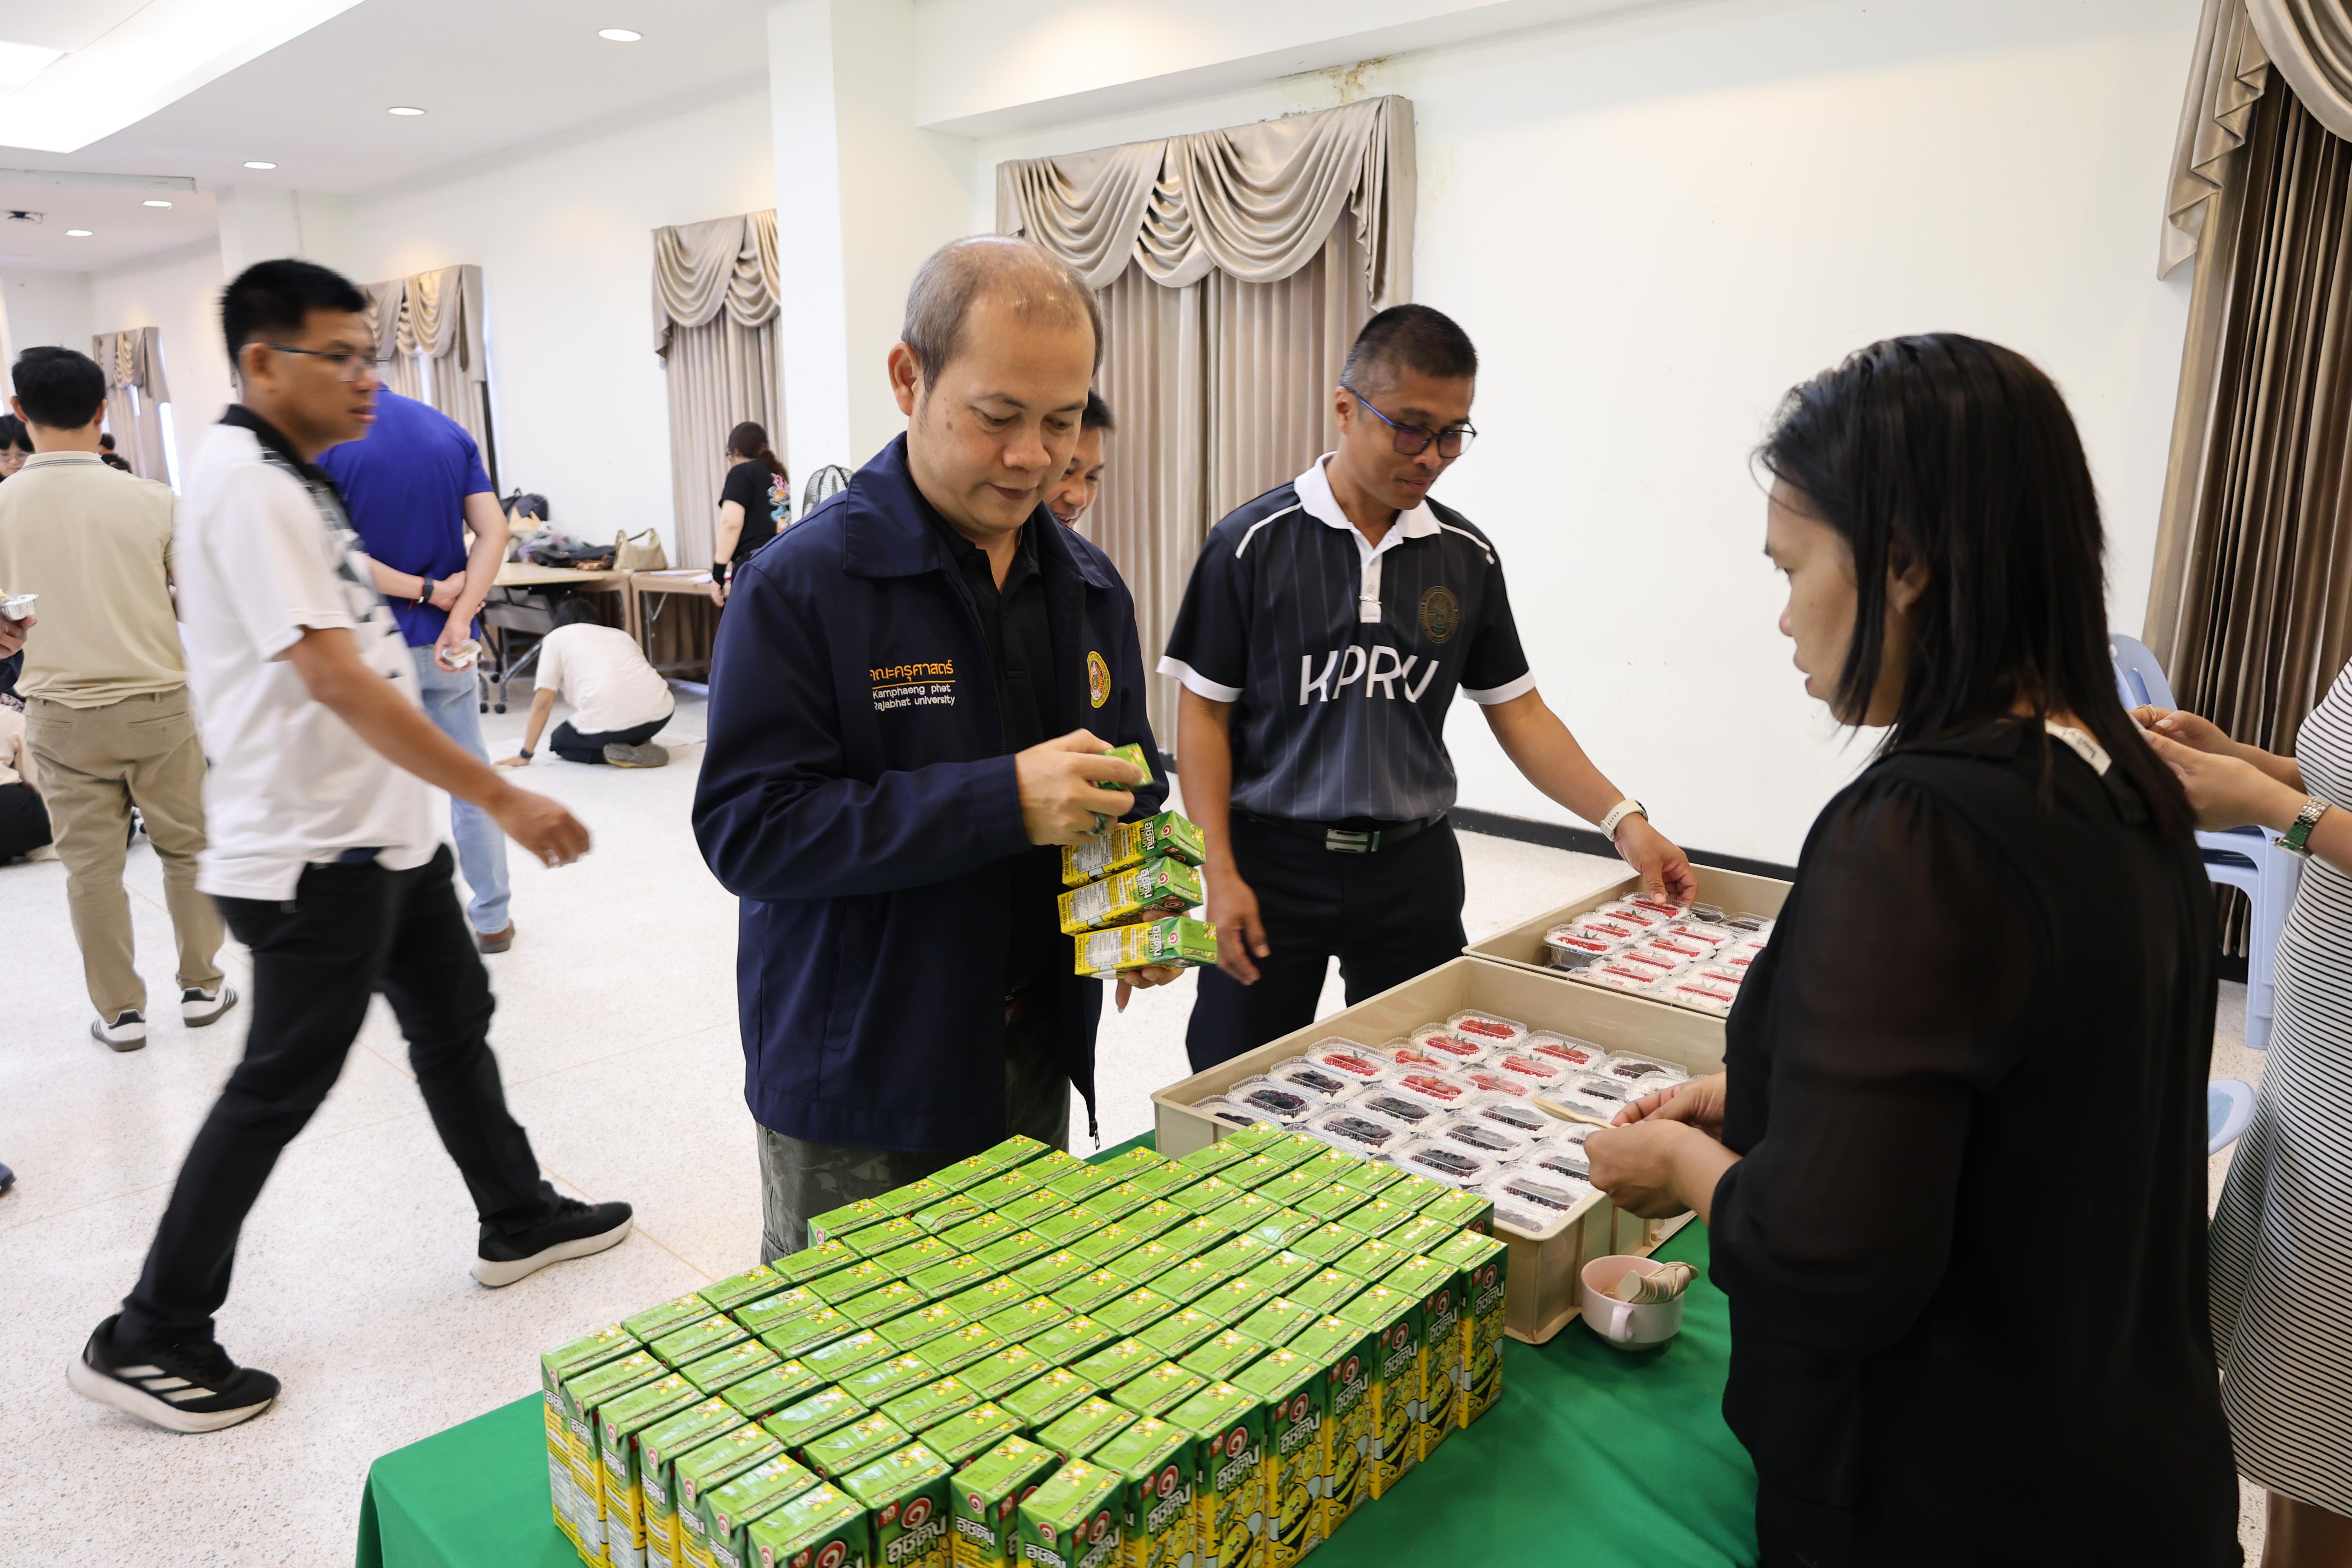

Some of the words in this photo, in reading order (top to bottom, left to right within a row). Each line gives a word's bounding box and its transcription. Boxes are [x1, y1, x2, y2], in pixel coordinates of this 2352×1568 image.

[873, 686, 926, 699] Kamphaeng
[931, 684, 951, 694] phet
[1299, 645, 1439, 706] KPRU
[914, 695, 955, 706] university
[887, 1514, 947, 1563] อิชิตัน
